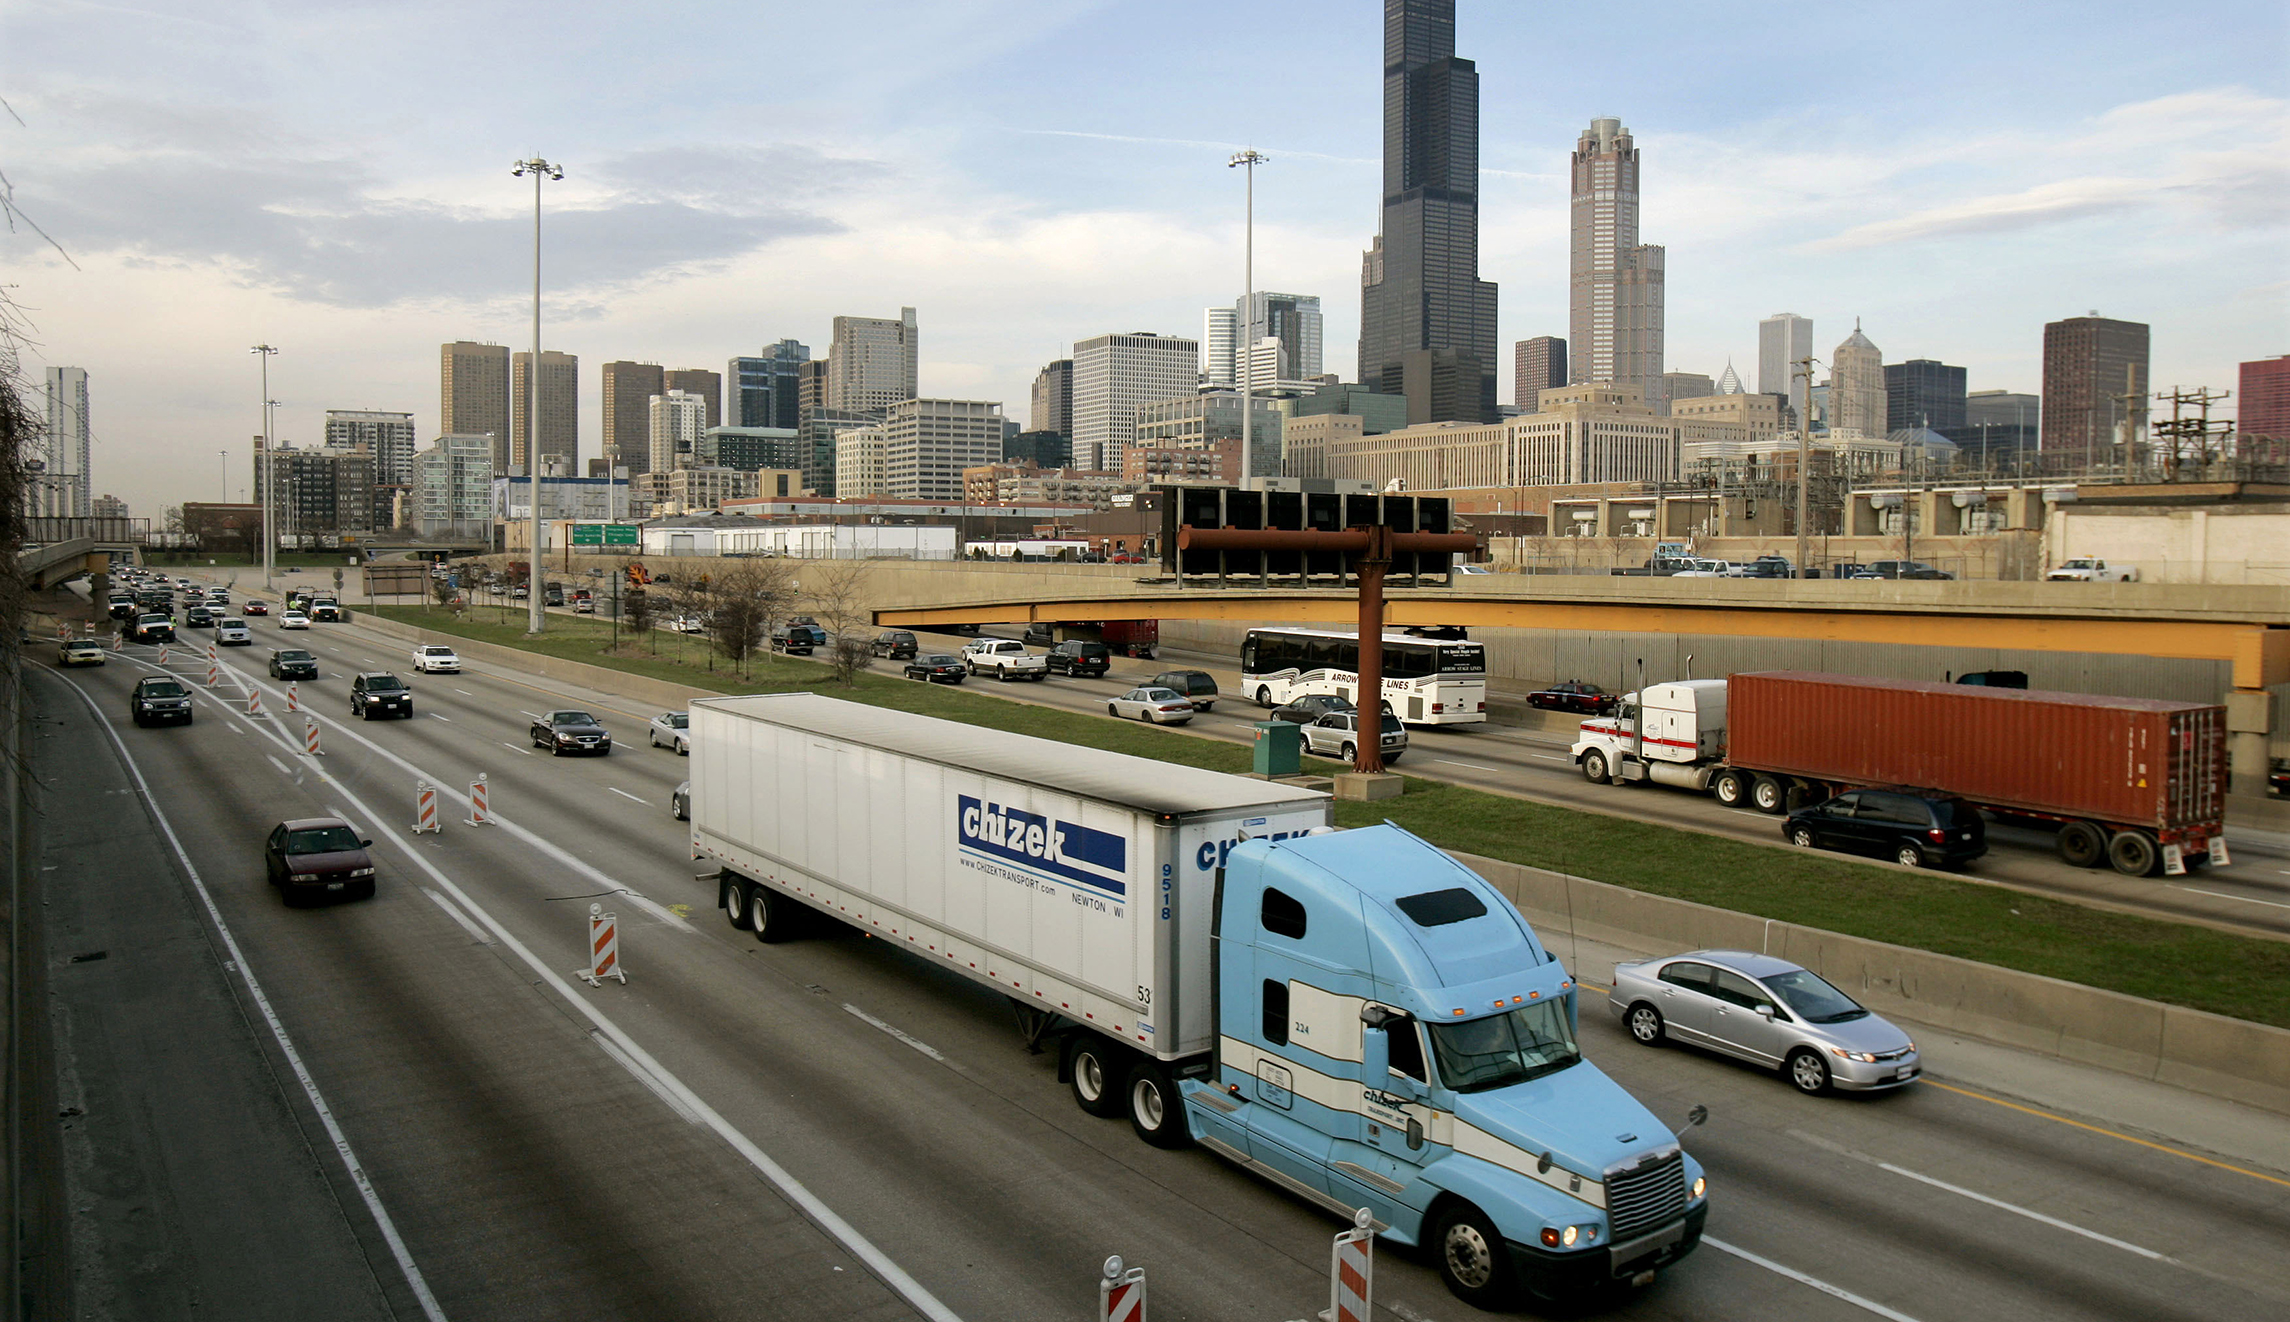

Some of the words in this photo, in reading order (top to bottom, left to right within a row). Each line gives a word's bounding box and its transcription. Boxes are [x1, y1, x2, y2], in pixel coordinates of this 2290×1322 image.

[1331, 673, 1359, 684] ARROW
[1386, 679, 1409, 690] LINES
[963, 799, 1065, 863] chizek
[1294, 1021, 1309, 1035] 224
